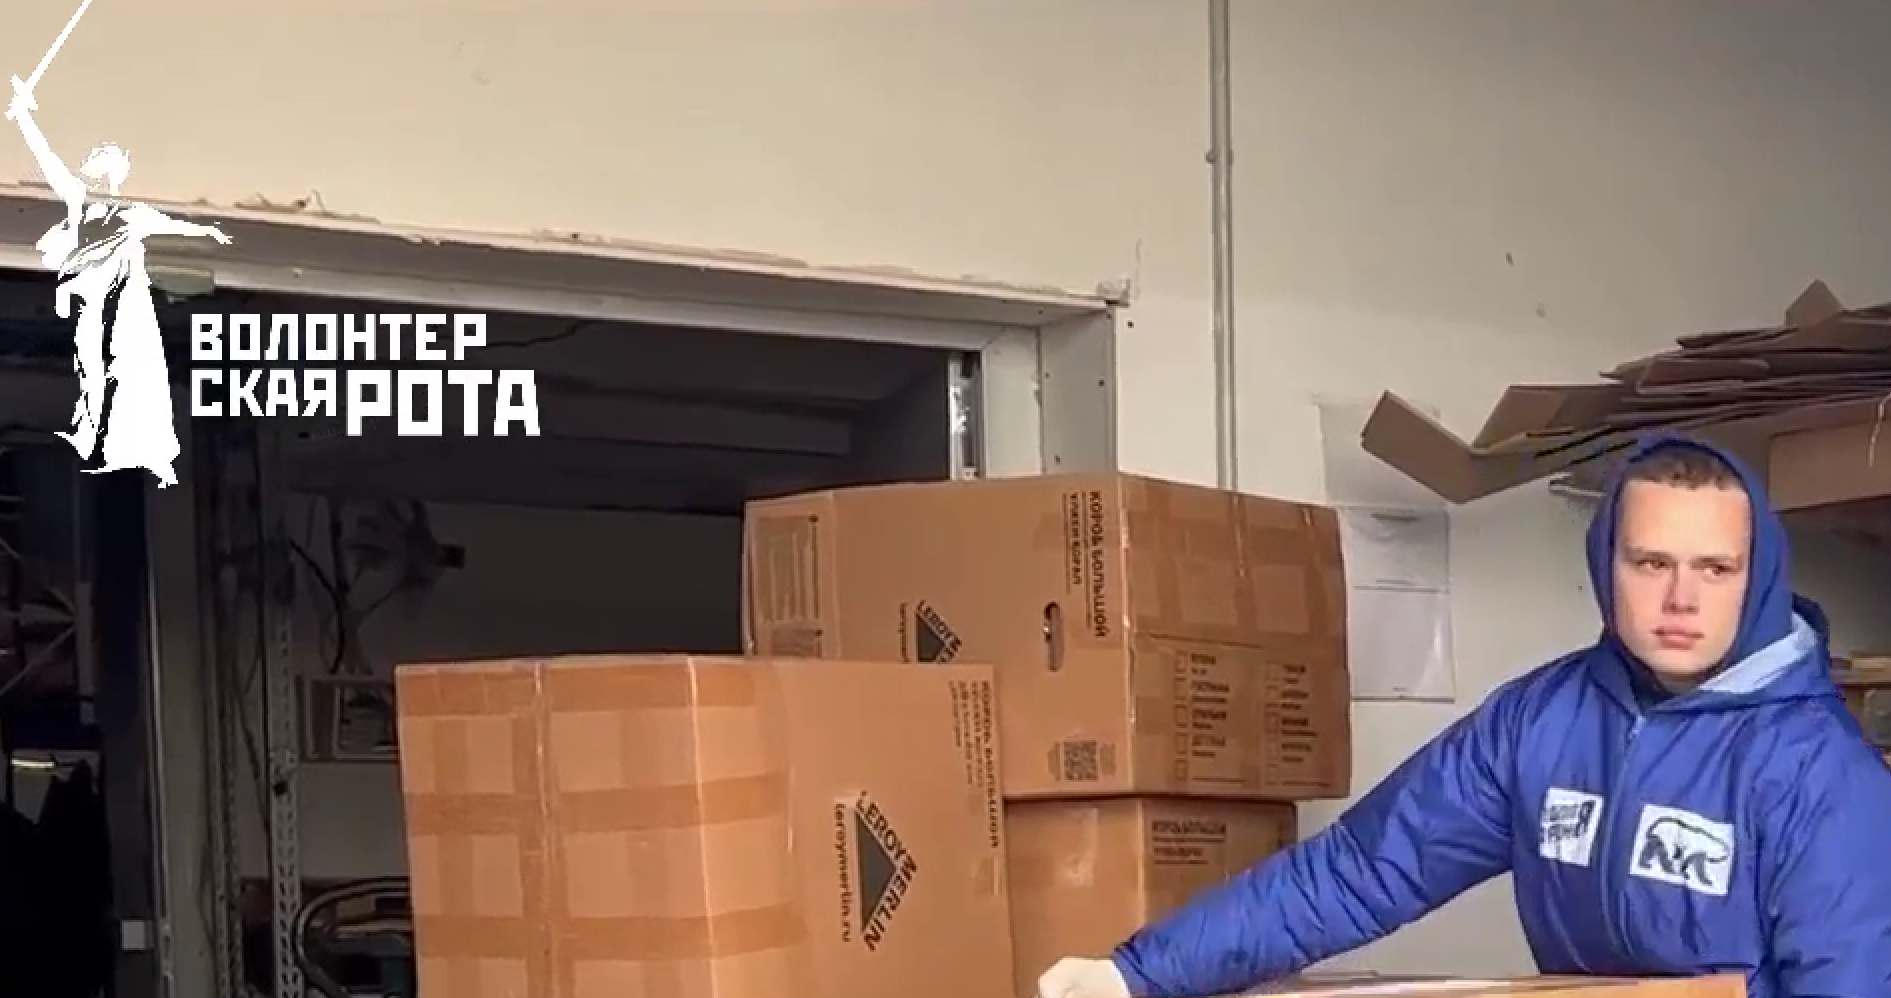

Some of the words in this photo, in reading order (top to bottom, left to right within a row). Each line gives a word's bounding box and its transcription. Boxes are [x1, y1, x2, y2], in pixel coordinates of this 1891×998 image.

[834, 802, 852, 942] leroymerlin.ru
[855, 789, 907, 861] LEROY
[863, 852, 917, 951] MERLIN
